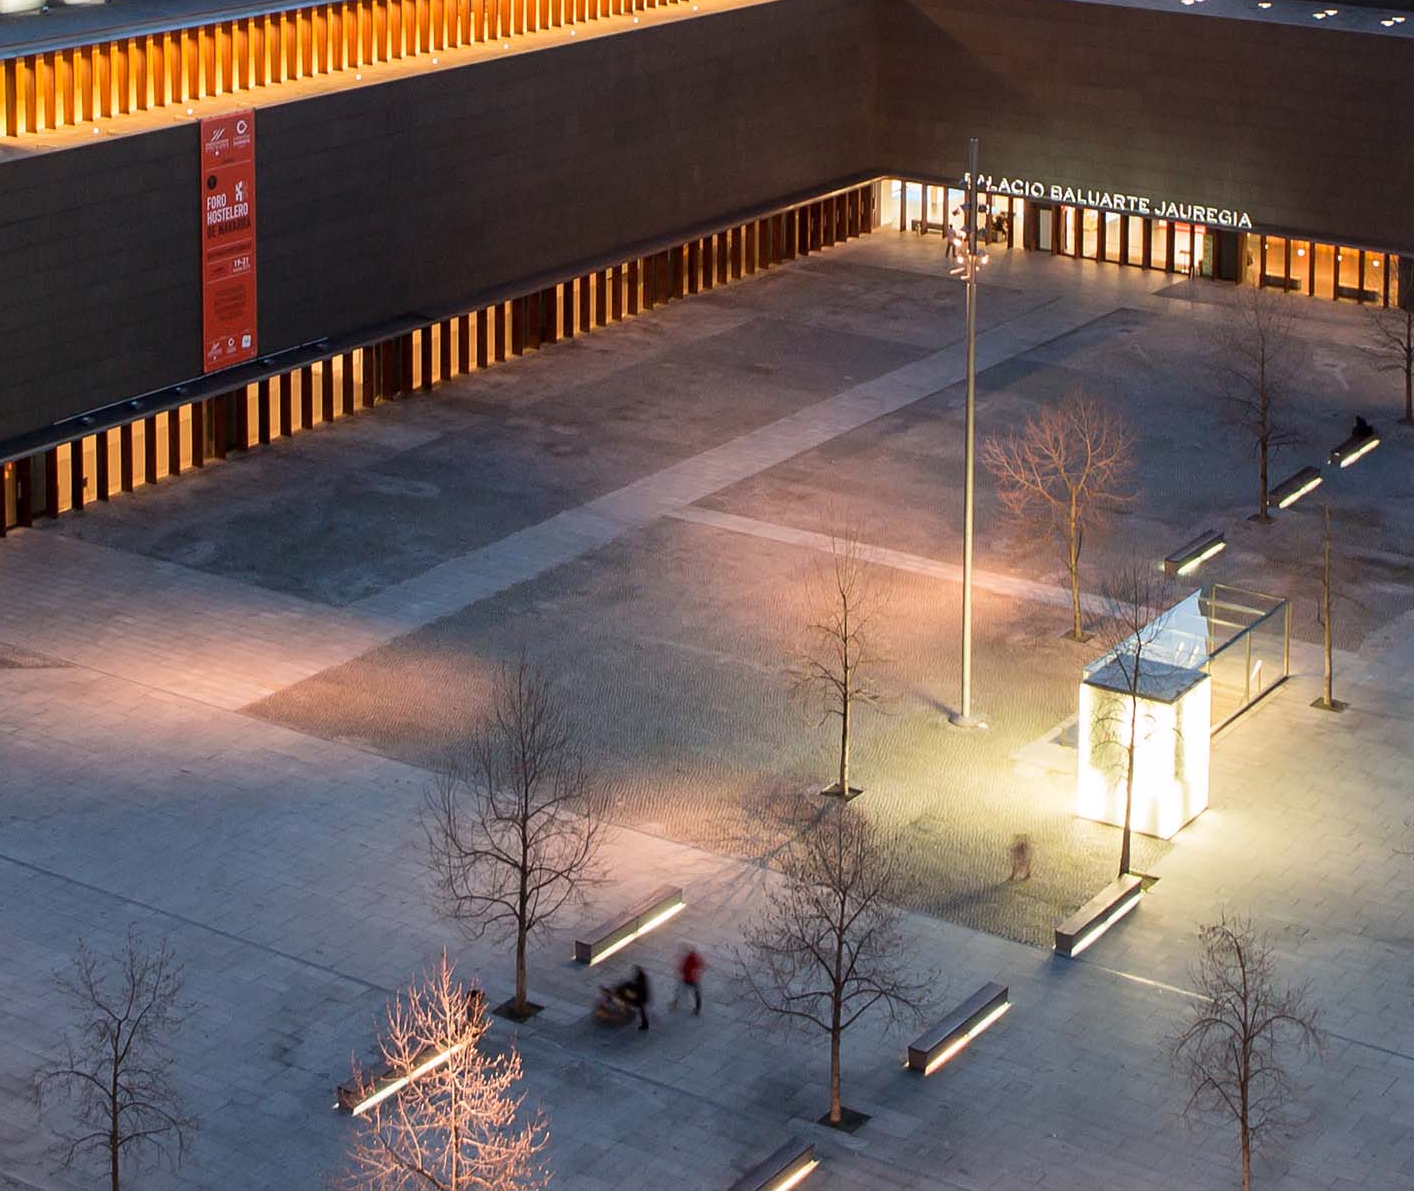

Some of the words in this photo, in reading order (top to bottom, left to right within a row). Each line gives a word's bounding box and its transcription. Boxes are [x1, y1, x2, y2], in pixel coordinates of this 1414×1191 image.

[207, 194, 226, 211] FORO
[1051, 184, 1150, 214] BALUARTE
[1154, 199, 1253, 229] JAUREGIA
[207, 203, 248, 225] HOSTELERO
